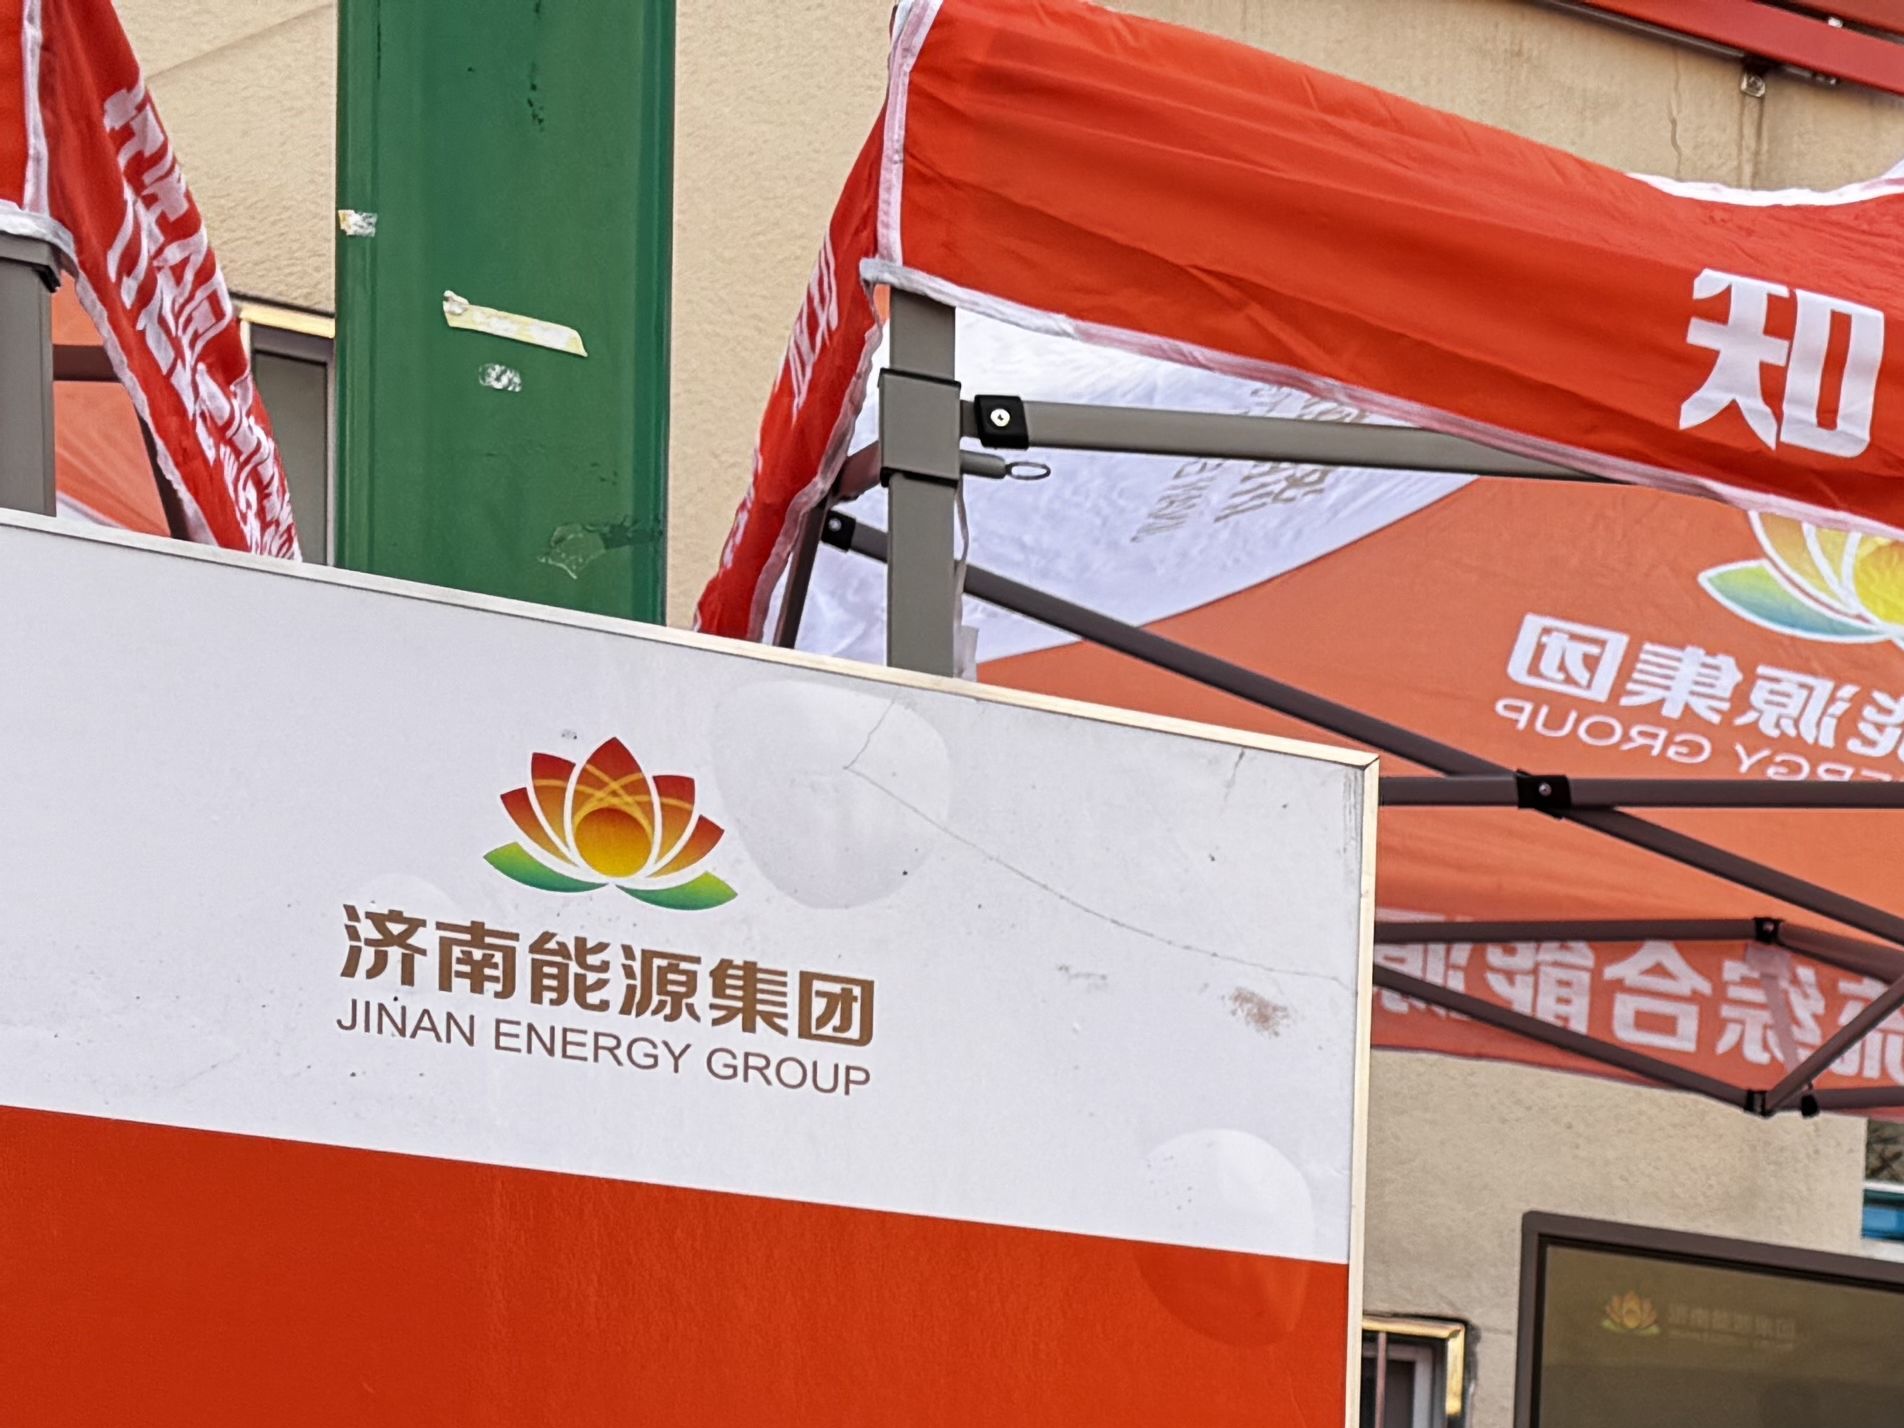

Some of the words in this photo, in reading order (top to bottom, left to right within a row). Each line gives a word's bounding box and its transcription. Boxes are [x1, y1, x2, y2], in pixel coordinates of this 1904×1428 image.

[340, 902, 875, 1048] 济南能源集团
[336, 998, 476, 1048] JINAN
[494, 1018, 692, 1074] ENERGY
[706, 1047, 871, 1097] GROUP
